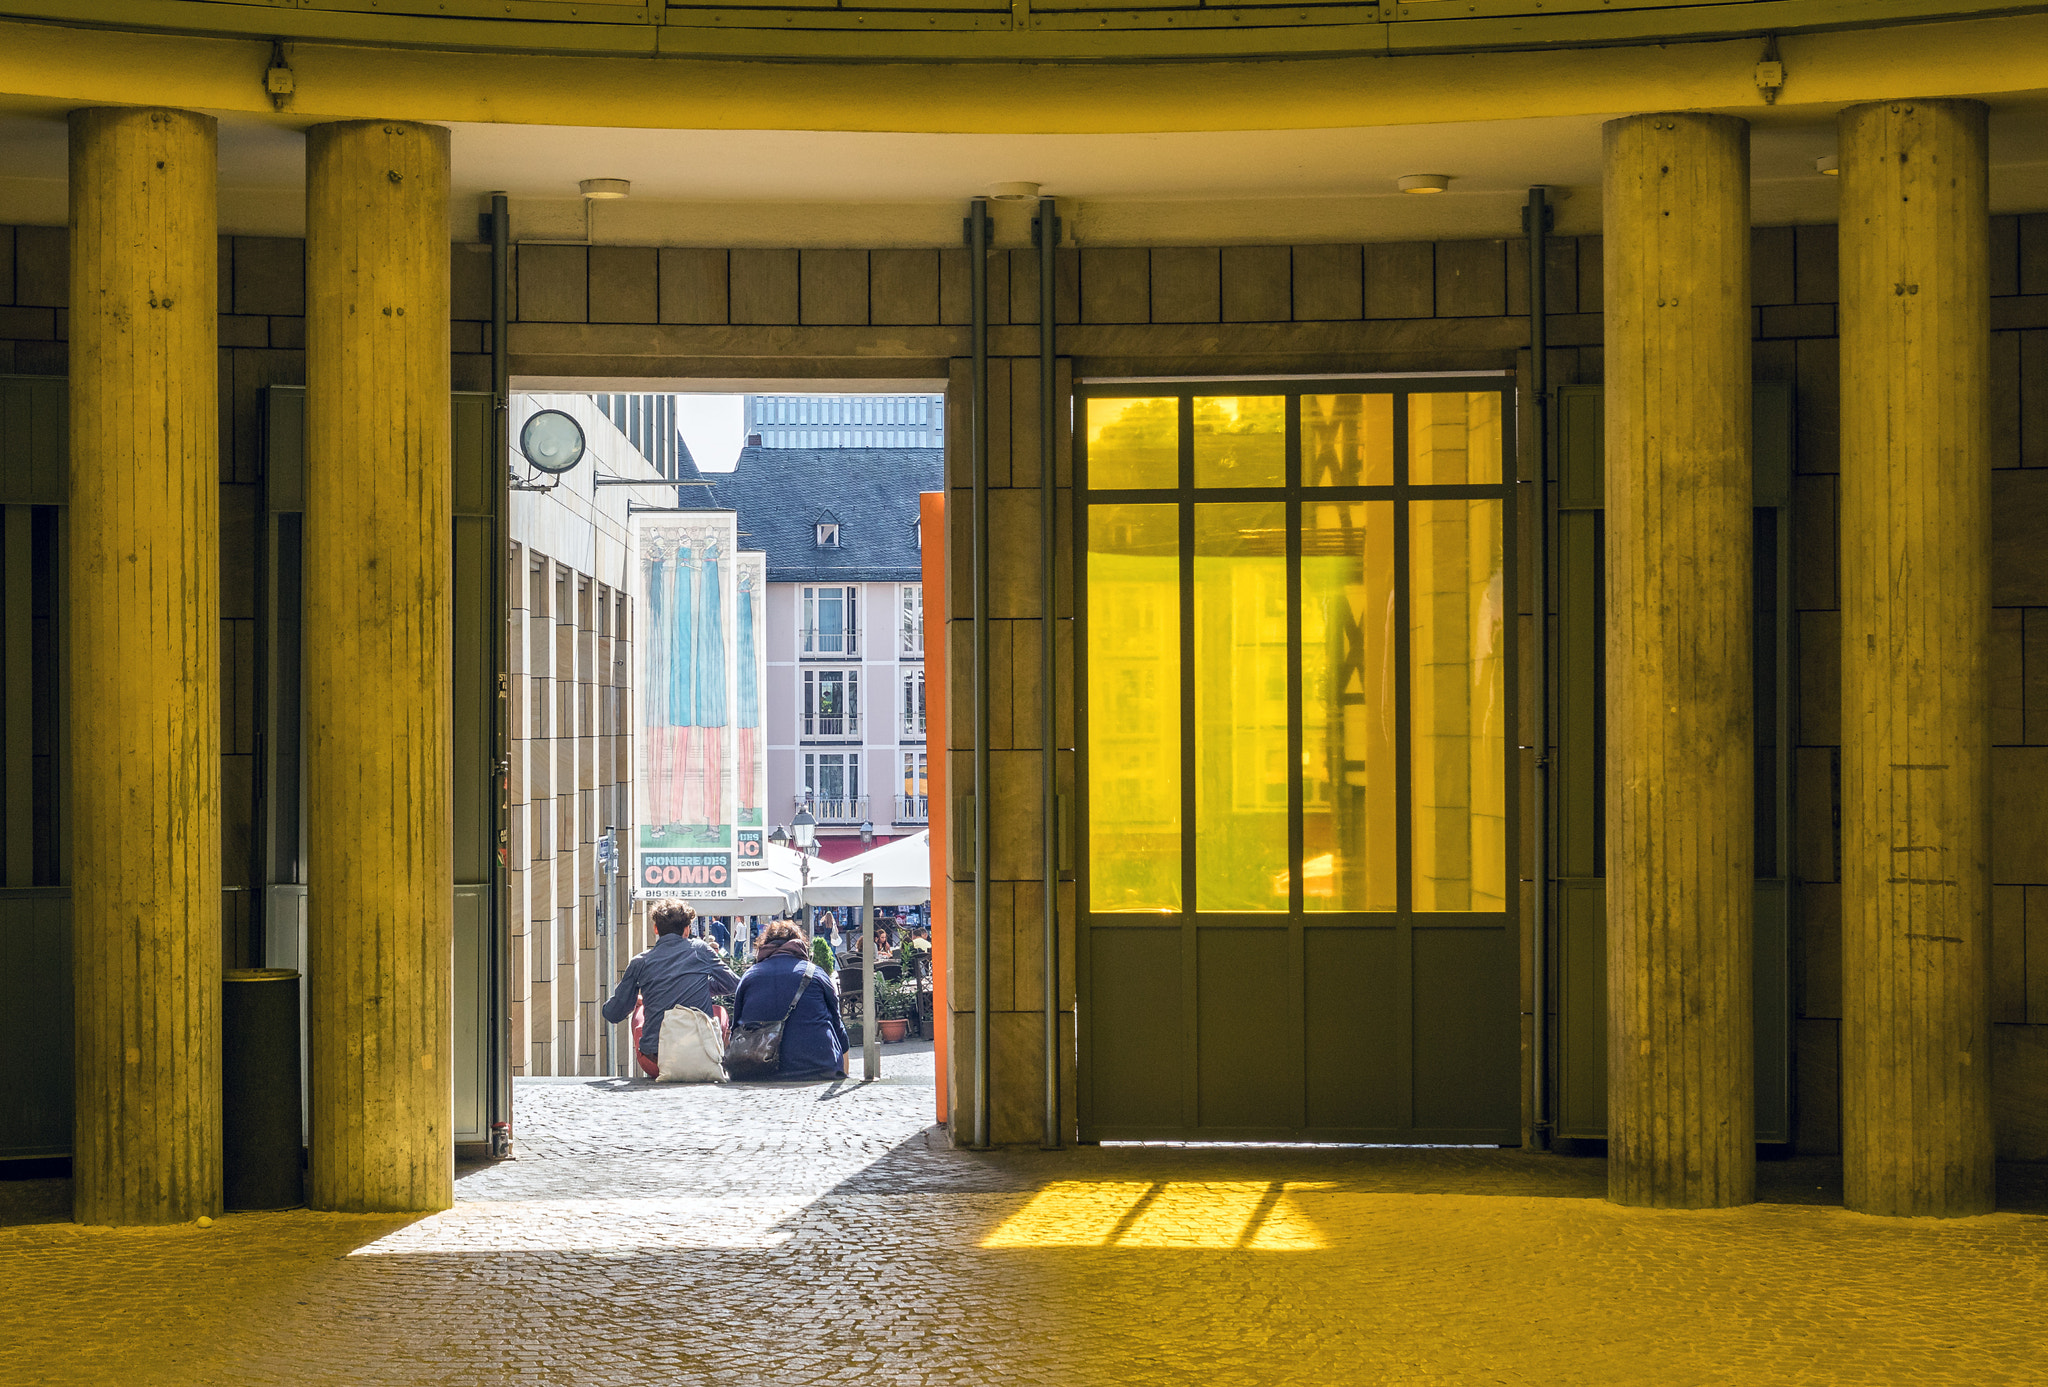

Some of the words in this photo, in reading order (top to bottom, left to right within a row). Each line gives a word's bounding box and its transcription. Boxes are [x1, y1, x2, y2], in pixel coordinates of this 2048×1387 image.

[740, 833, 759, 841] DES
[738, 840, 760, 856] IC
[645, 856, 701, 865] PIONIERE
[703, 856, 727, 865] DES
[645, 866, 727, 884] COMIC
